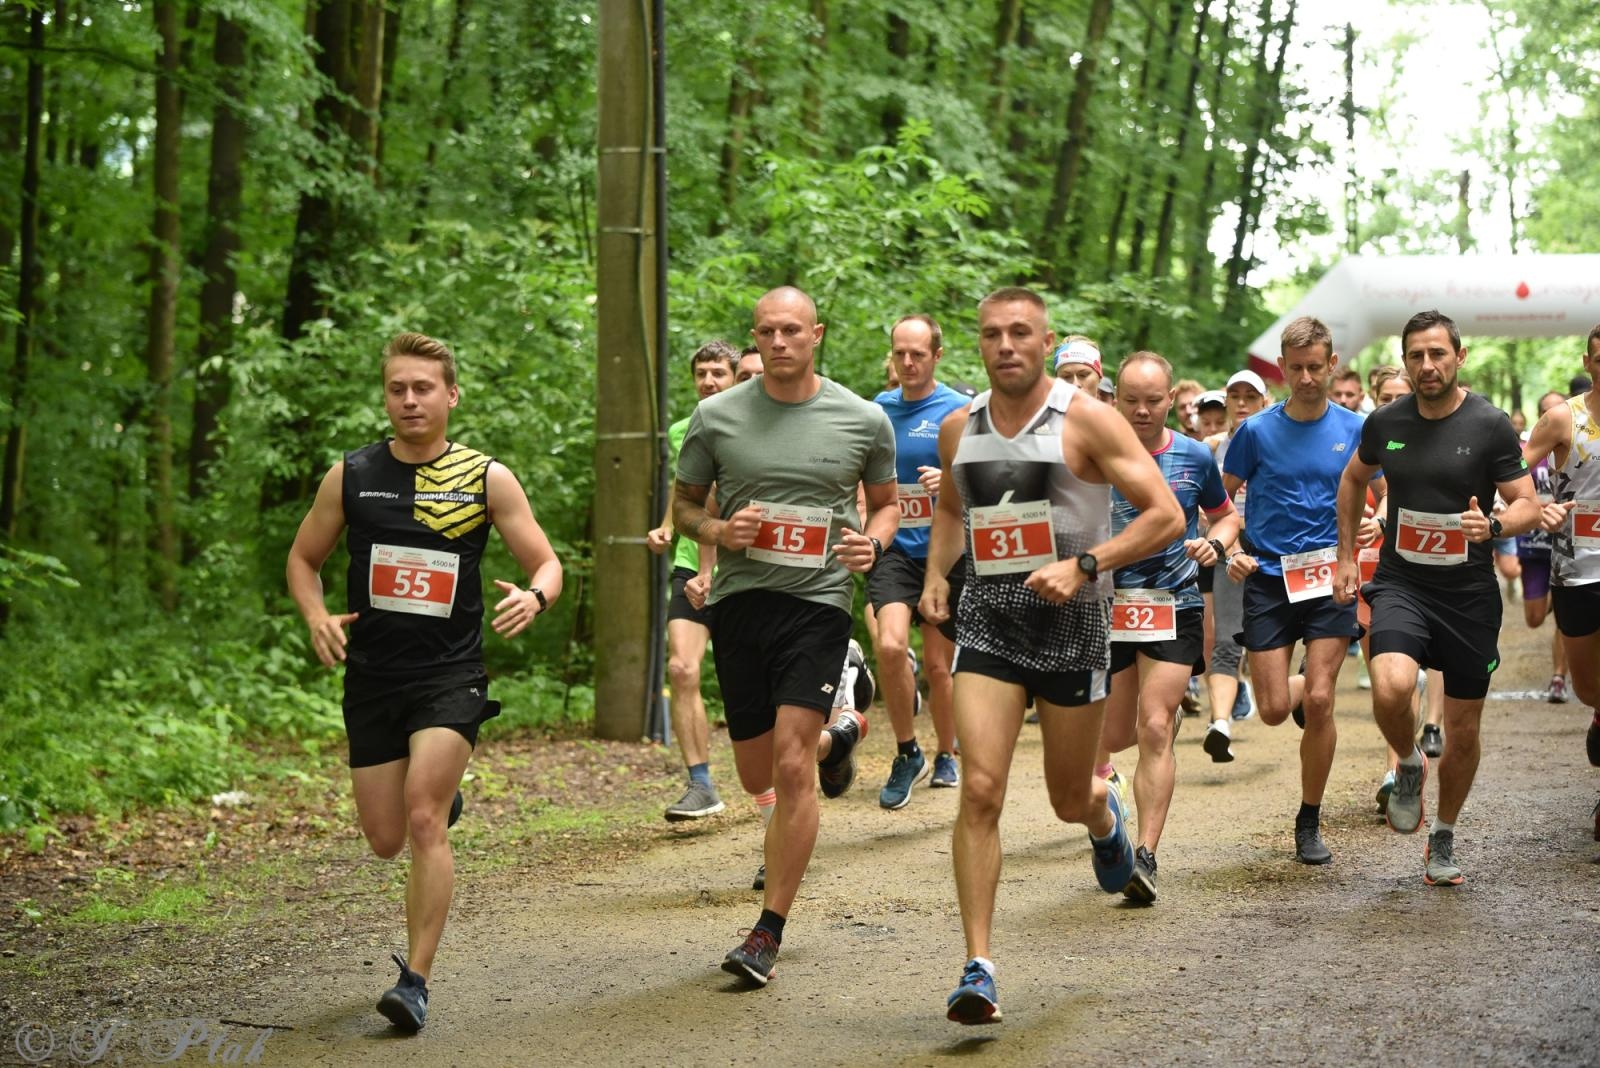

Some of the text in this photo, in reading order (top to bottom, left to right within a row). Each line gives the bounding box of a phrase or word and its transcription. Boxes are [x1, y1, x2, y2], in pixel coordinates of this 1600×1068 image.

[414, 492, 475, 502] RUNMAGEDDON
[1022, 511, 1039, 519] 4500
[772, 525, 807, 552] 15
[990, 527, 1029, 558] 31
[1415, 529, 1447, 553] 72
[431, 559, 448, 568] 4500
[448, 561, 456, 569] M
[392, 569, 432, 598] 55
[1304, 565, 1332, 588] 59
[1124, 607, 1155, 629] 32
